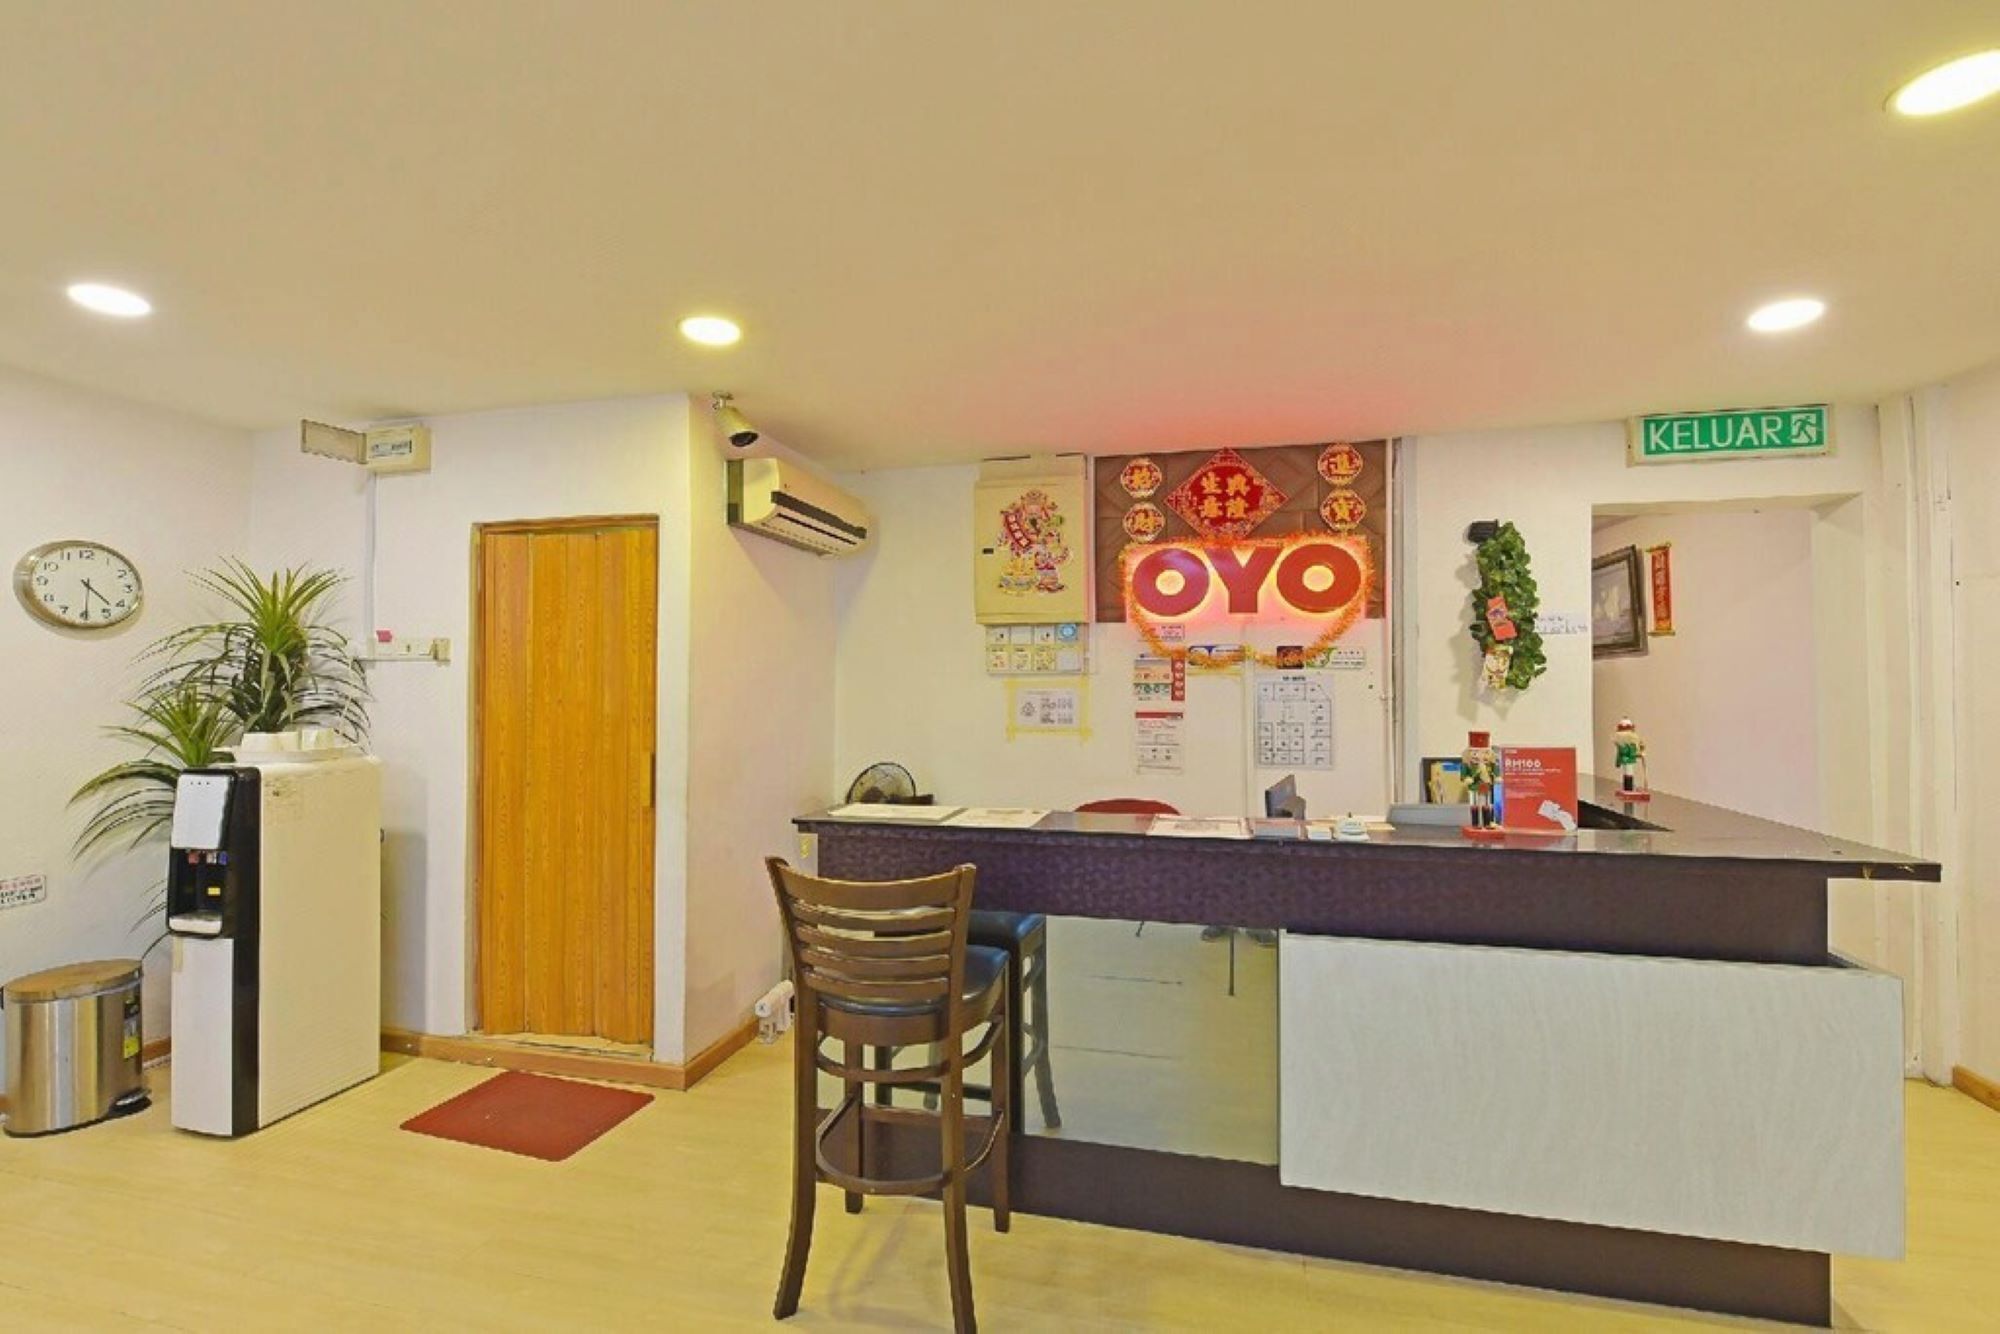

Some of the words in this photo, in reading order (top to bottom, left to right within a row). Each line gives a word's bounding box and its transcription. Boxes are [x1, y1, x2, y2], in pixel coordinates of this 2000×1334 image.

[1649, 415, 1783, 451] KELUAR
[79, 549, 95, 560] 12
[43, 561, 59, 572] 10
[1132, 543, 1362, 617] OYO
